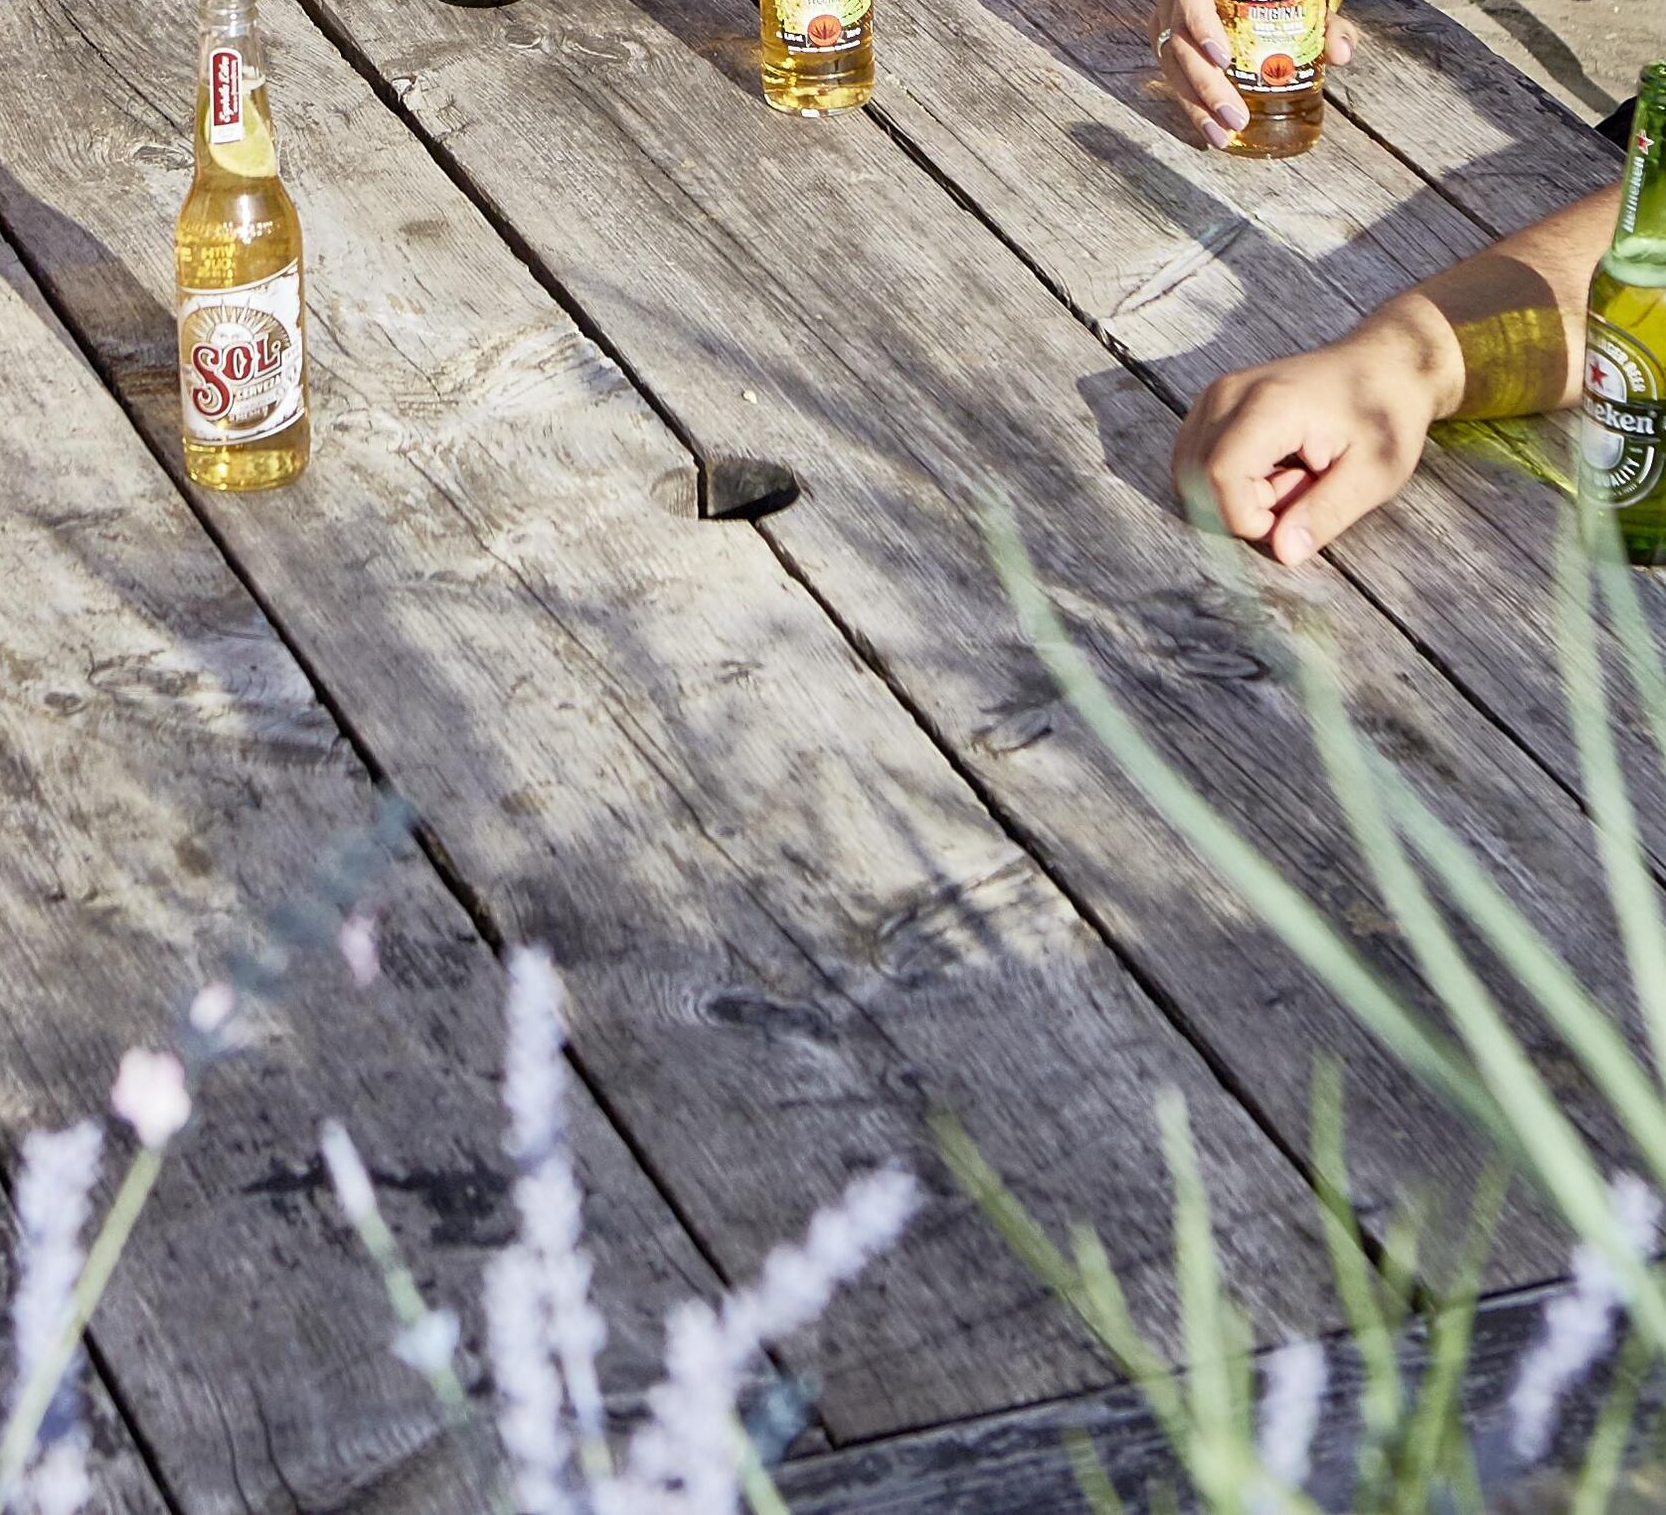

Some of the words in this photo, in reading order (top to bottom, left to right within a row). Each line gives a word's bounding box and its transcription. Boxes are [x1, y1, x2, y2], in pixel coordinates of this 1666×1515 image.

[1251, 5, 1305, 21] ORIGINAL
[191, 332, 283, 421] SOL
[236, 372, 282, 402] CERVEZA
